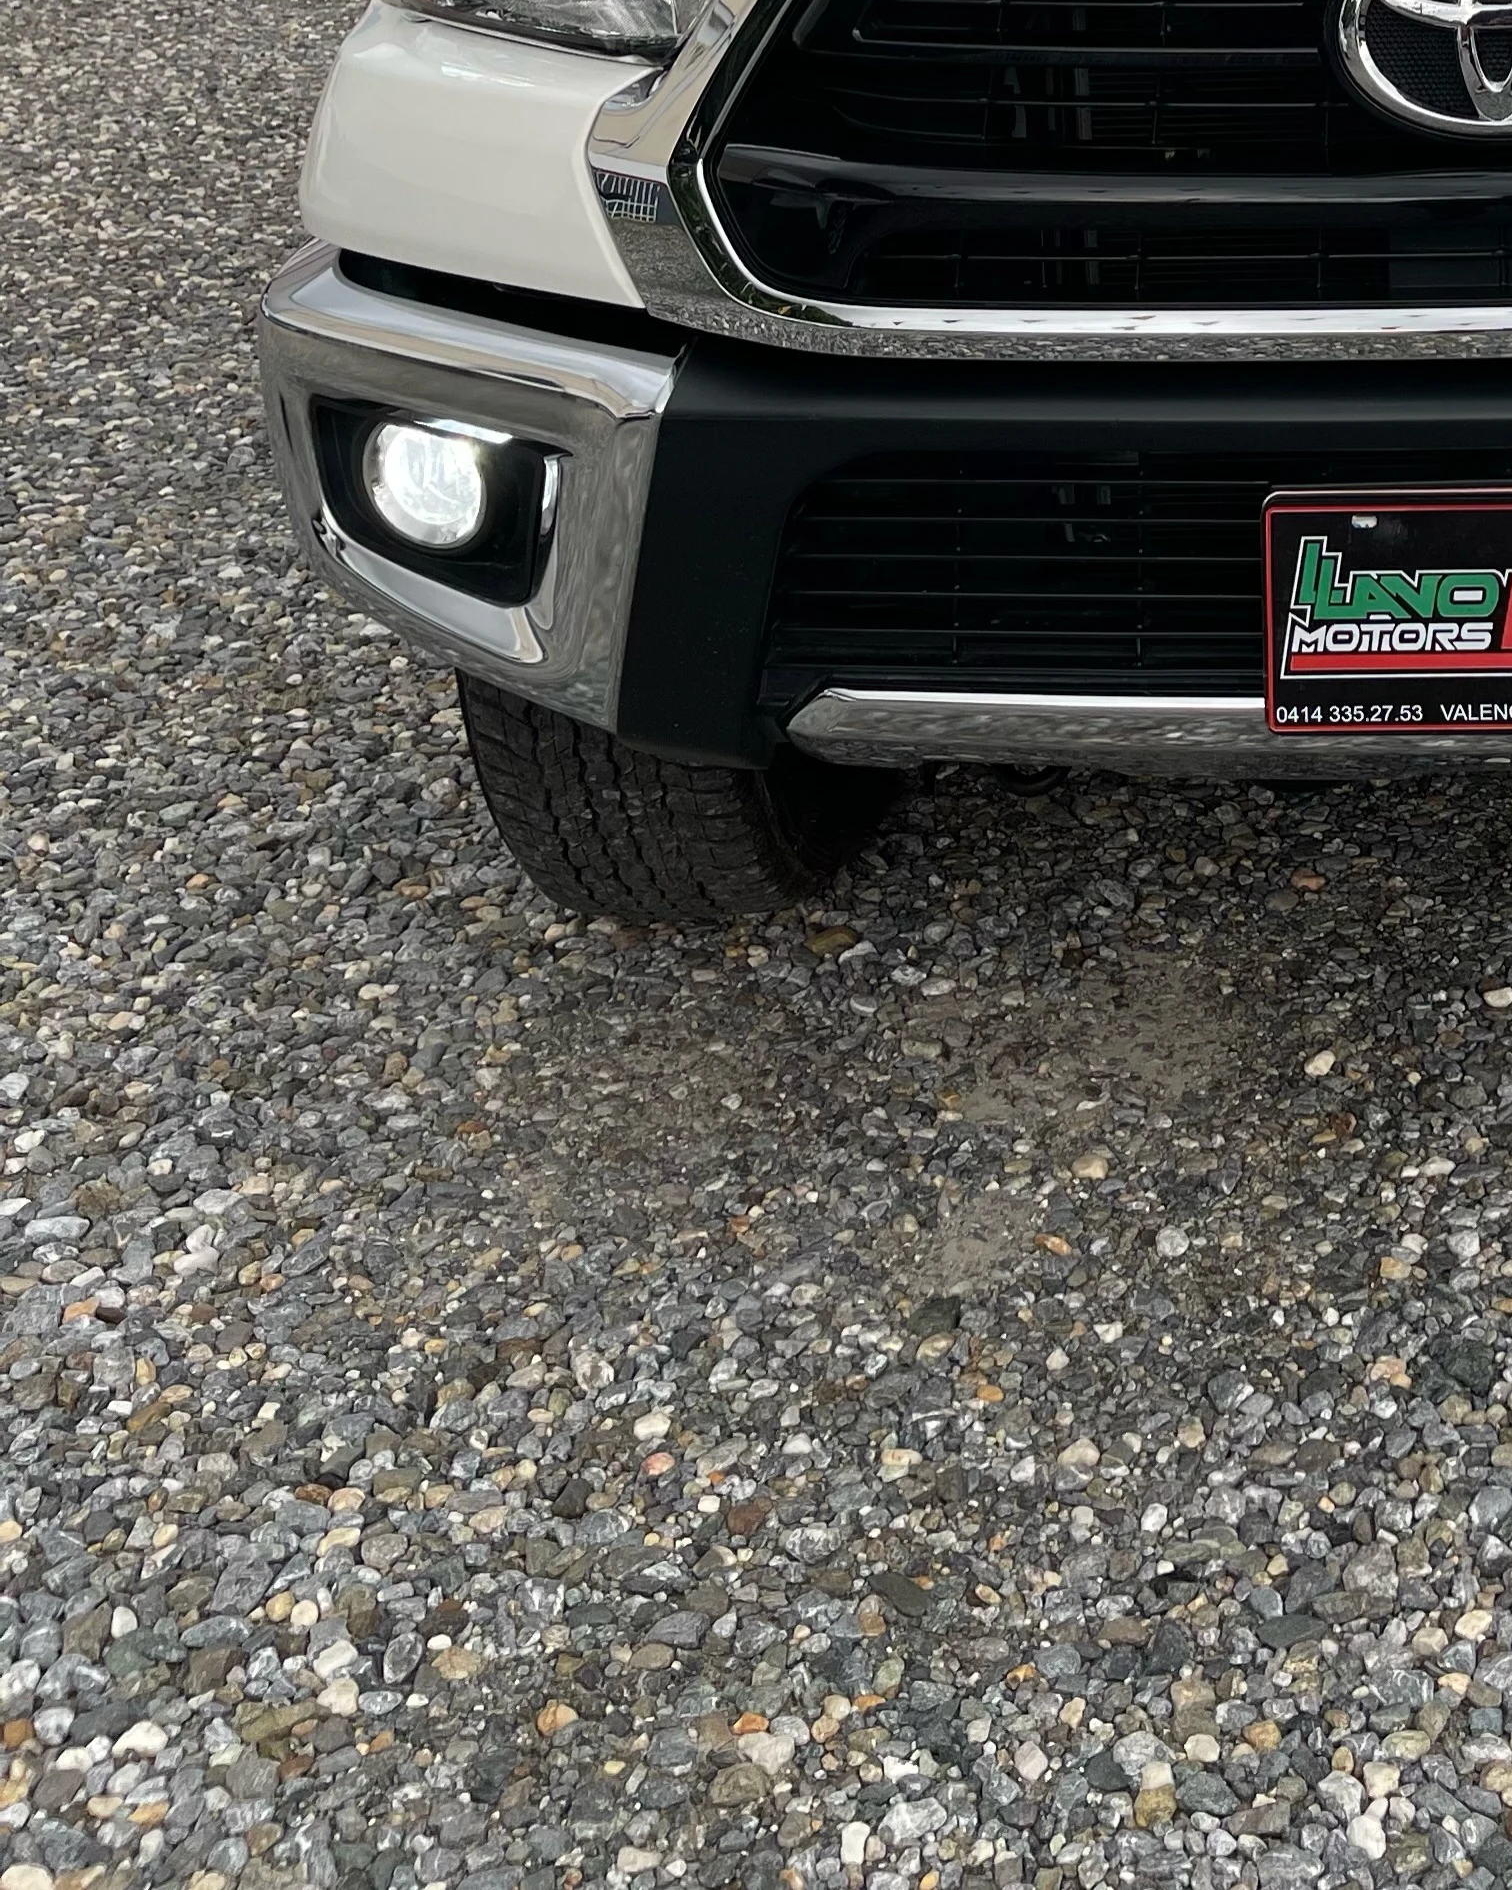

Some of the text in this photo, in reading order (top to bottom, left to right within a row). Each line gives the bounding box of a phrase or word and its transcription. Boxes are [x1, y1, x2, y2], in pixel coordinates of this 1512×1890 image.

[1299, 538, 1500, 619] LLANO
[1292, 622, 1493, 652] MOTORS
[1276, 706, 1323, 724] 0414
[1328, 704, 1423, 723] 335.27.53
